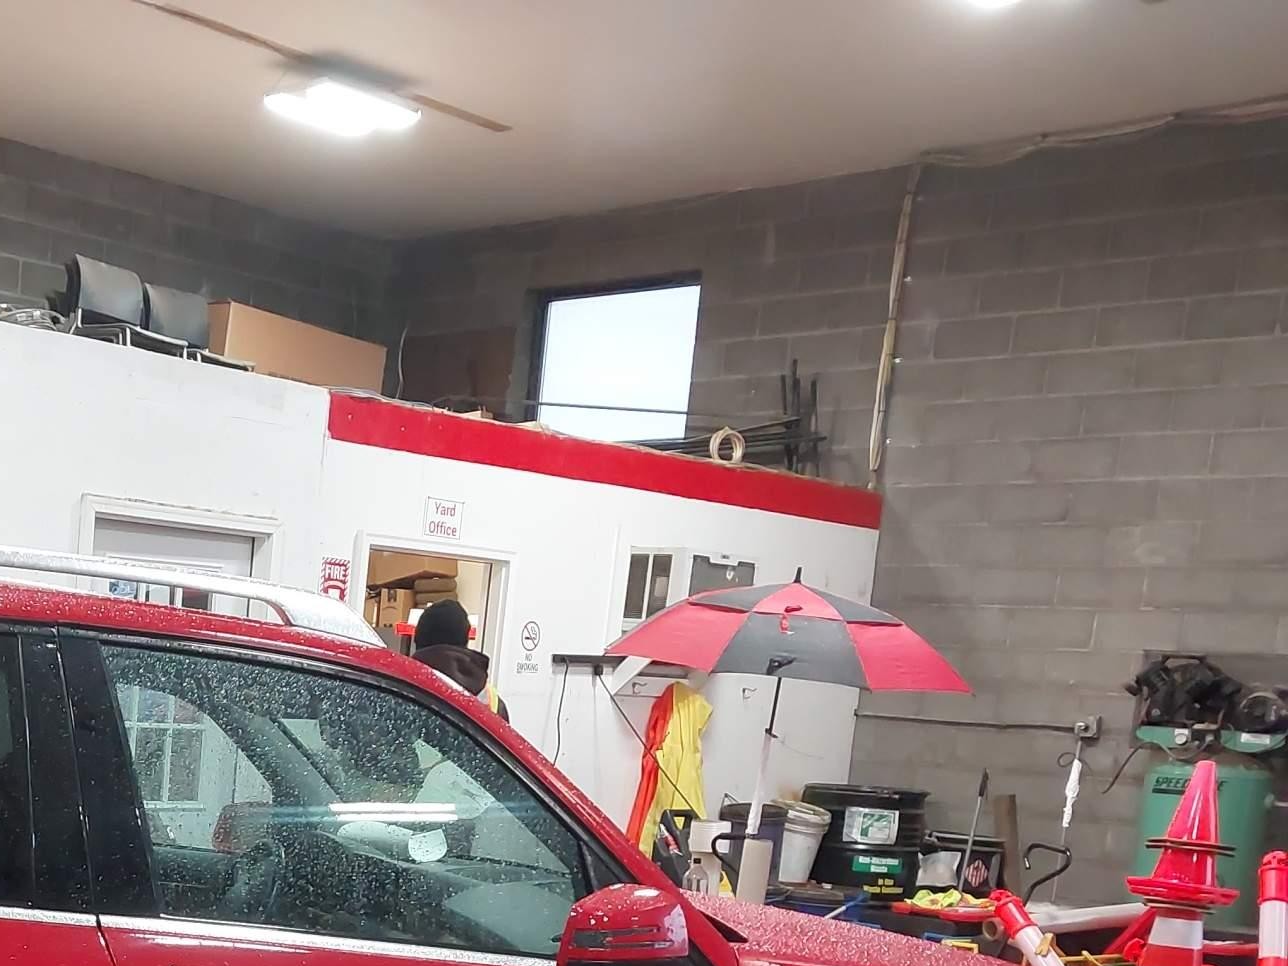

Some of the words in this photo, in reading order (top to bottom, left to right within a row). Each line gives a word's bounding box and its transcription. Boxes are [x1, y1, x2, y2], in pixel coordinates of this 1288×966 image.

[434, 501, 456, 517] Yard
[428, 520, 457, 537] Office
[325, 565, 346, 580] FIRE
